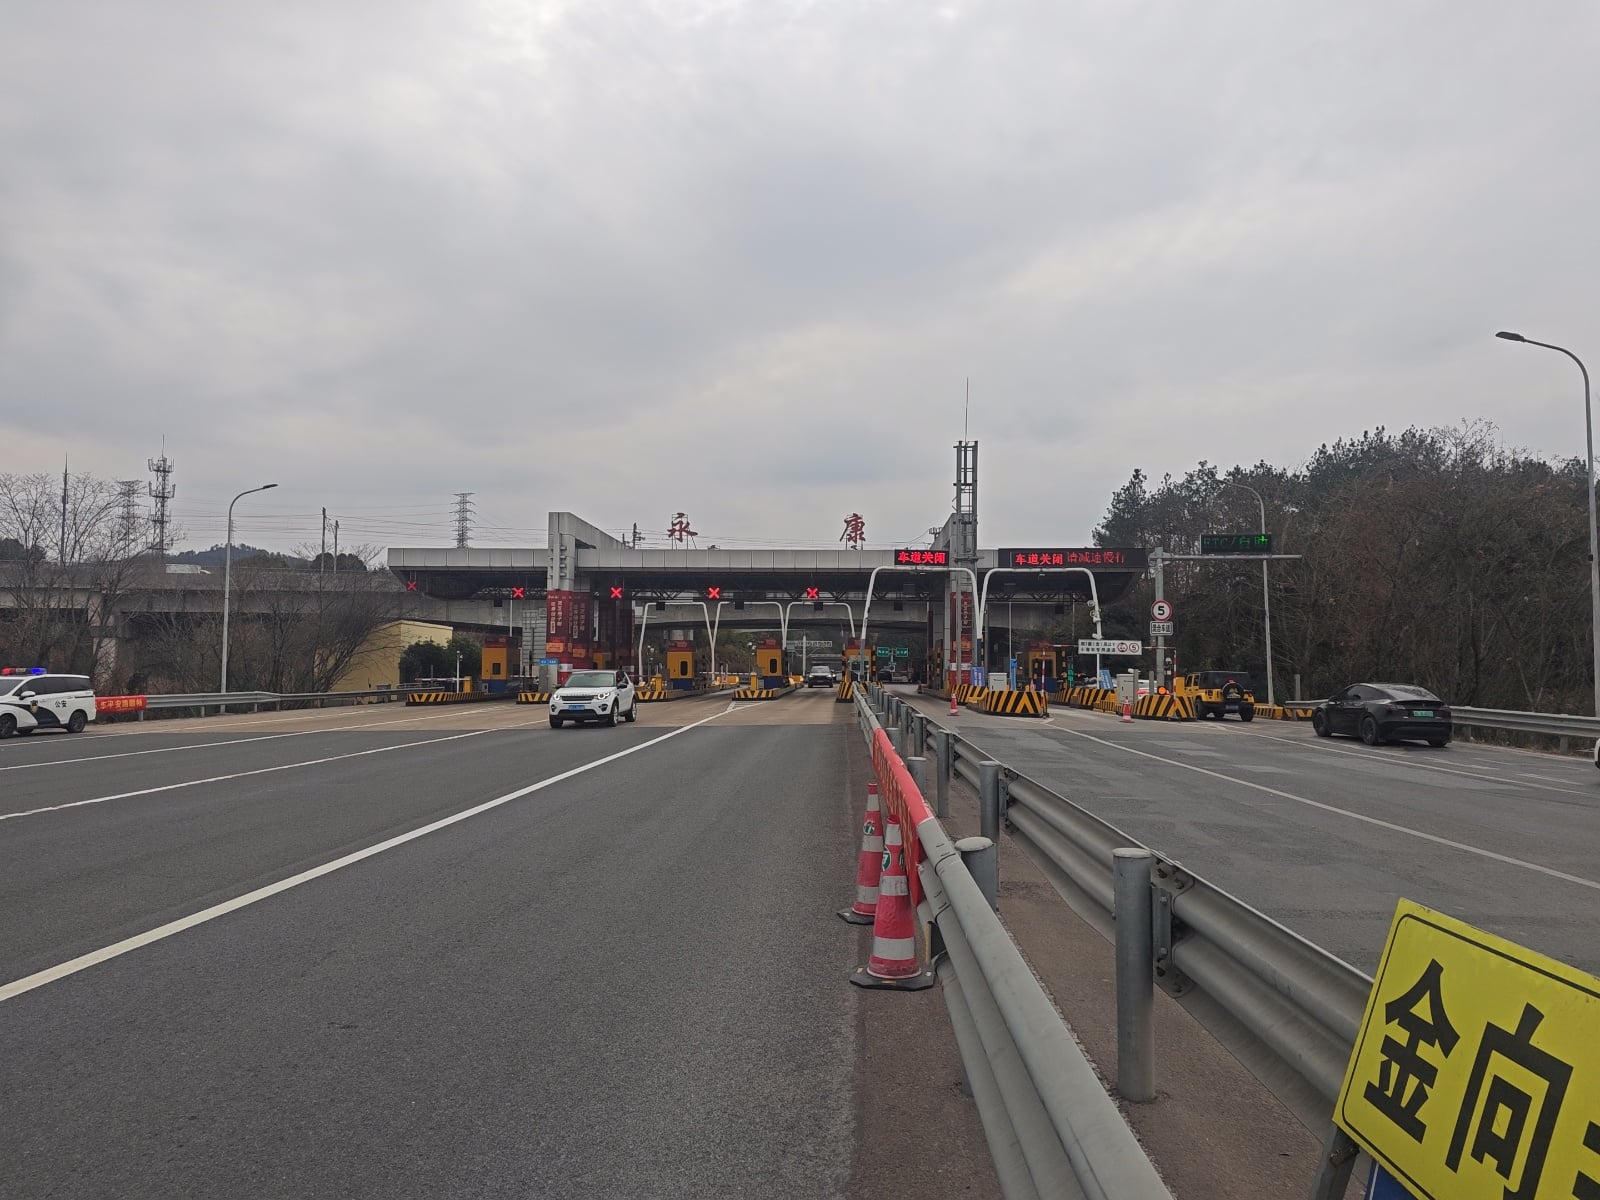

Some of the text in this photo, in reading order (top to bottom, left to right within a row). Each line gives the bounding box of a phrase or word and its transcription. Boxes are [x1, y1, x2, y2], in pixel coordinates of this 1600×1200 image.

[897, 550, 947, 565] 车道关闭
[1016, 553, 1063, 565] 车道关闭
[1158, 606, 1165, 616] 5
[54, 700, 68, 708] 公安
[1363, 958, 1600, 1200] 金向
